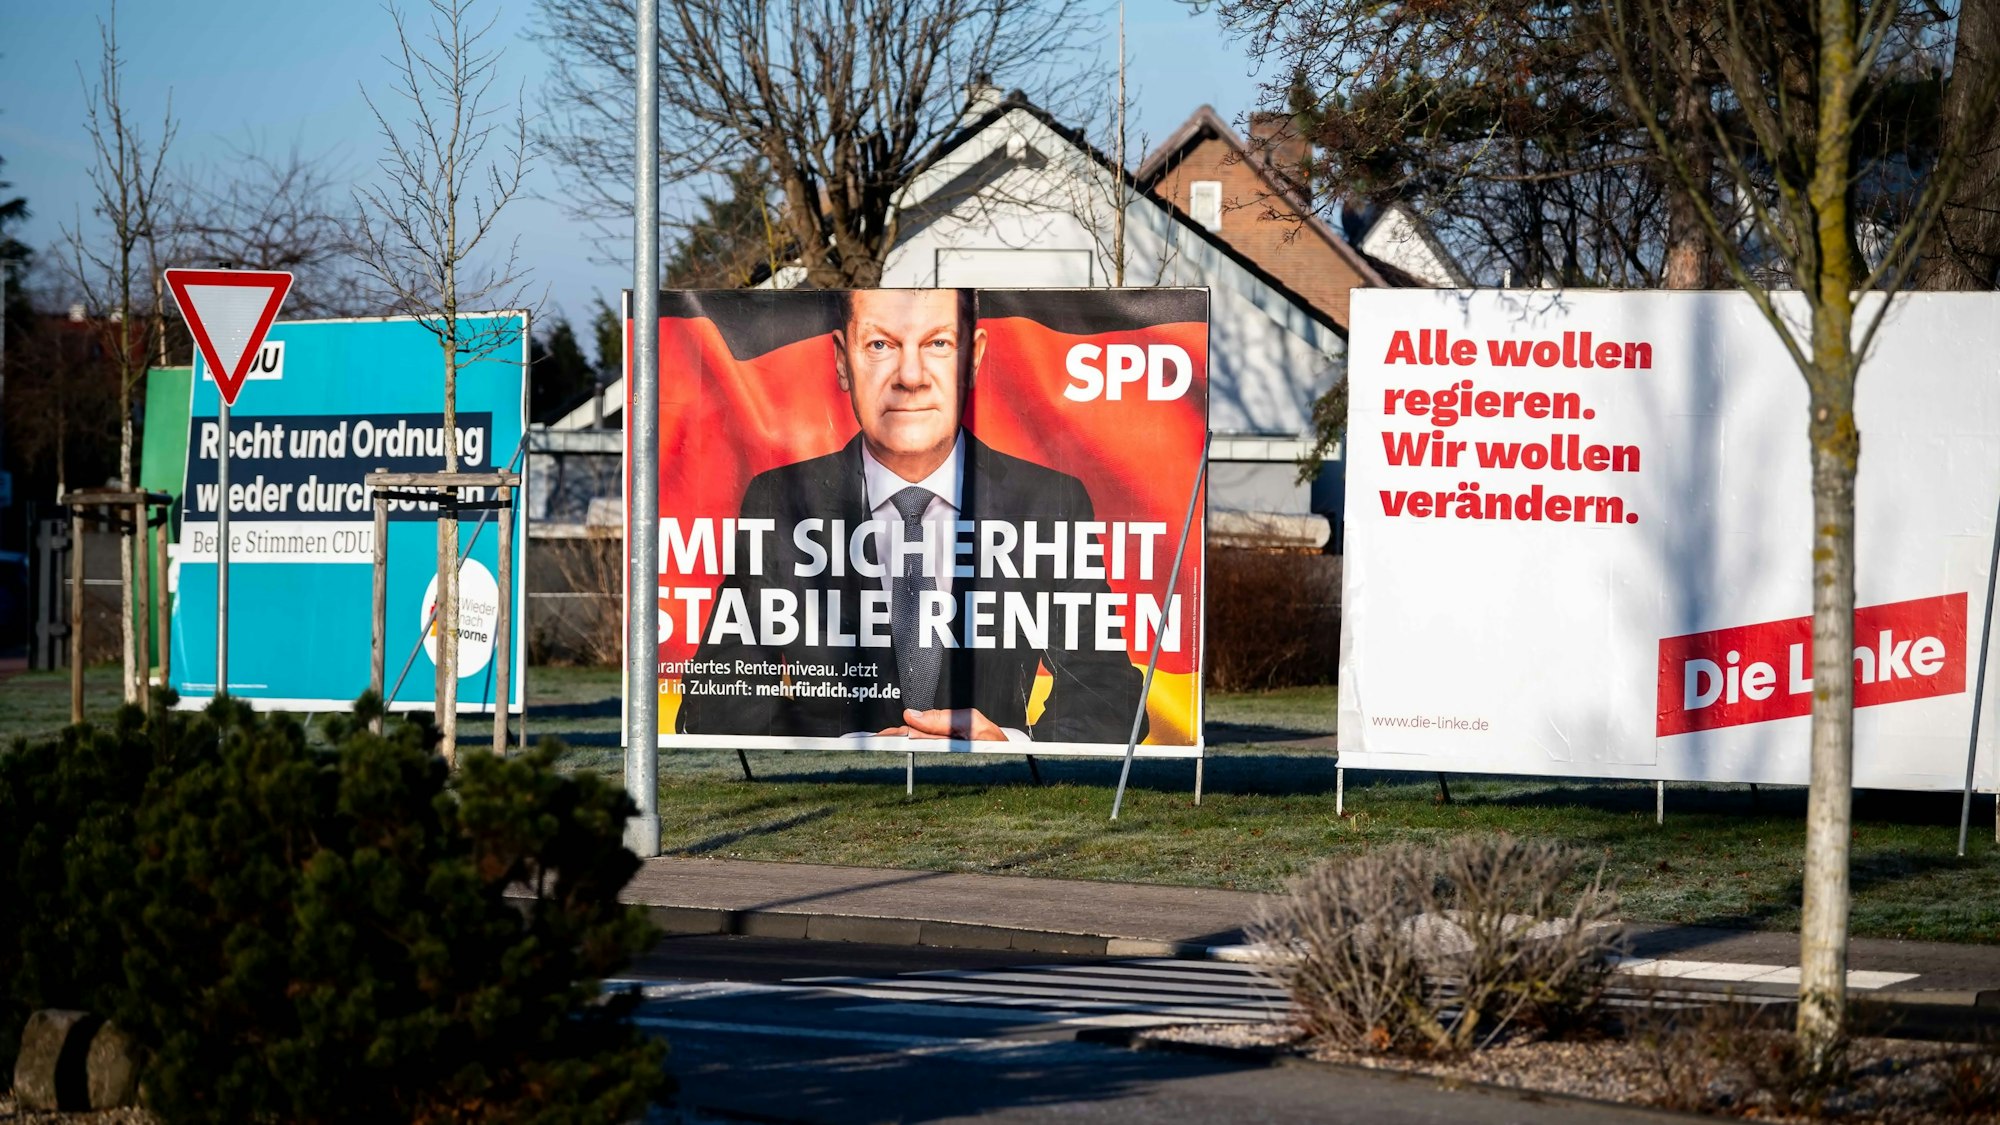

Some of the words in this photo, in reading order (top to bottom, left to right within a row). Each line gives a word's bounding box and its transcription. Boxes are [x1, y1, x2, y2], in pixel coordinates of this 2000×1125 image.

[1384, 329, 1478, 366] Alle
[1487, 331, 1653, 369] wollen
[1063, 343, 1193, 402] SPD
[1384, 379, 1596, 427] regieren.
[290, 421, 347, 459] und
[1381, 429, 1467, 467] Wir
[1475, 433, 1641, 472] wollen
[196, 475, 293, 512] weder
[1379, 481, 1639, 524] verändern.
[193, 530, 241, 553] Bee
[246, 530, 327, 554] Stimmen
[332, 530, 374, 554] CDU.
[658, 517, 775, 576] MIT
[793, 518, 1167, 581] SICHERHEIT
[460, 613, 484, 628] nach
[461, 598, 497, 616] Wieder
[919, 590, 1182, 652] RENTEN
[458, 628, 488, 643] vorne
[658, 659, 731, 675] rantiertes
[735, 660, 839, 677] Rentenniveau.
[842, 662, 879, 678] Jetzt
[1684, 650, 1777, 710] Die
[1789, 630, 1946, 695] Lnke
[673, 679, 686, 695] in
[690, 679, 752, 696] Zukunft:
[756, 680, 901, 703] mehrfürdich.spd.de
[1371, 715, 1489, 732] www.die-linke.de
